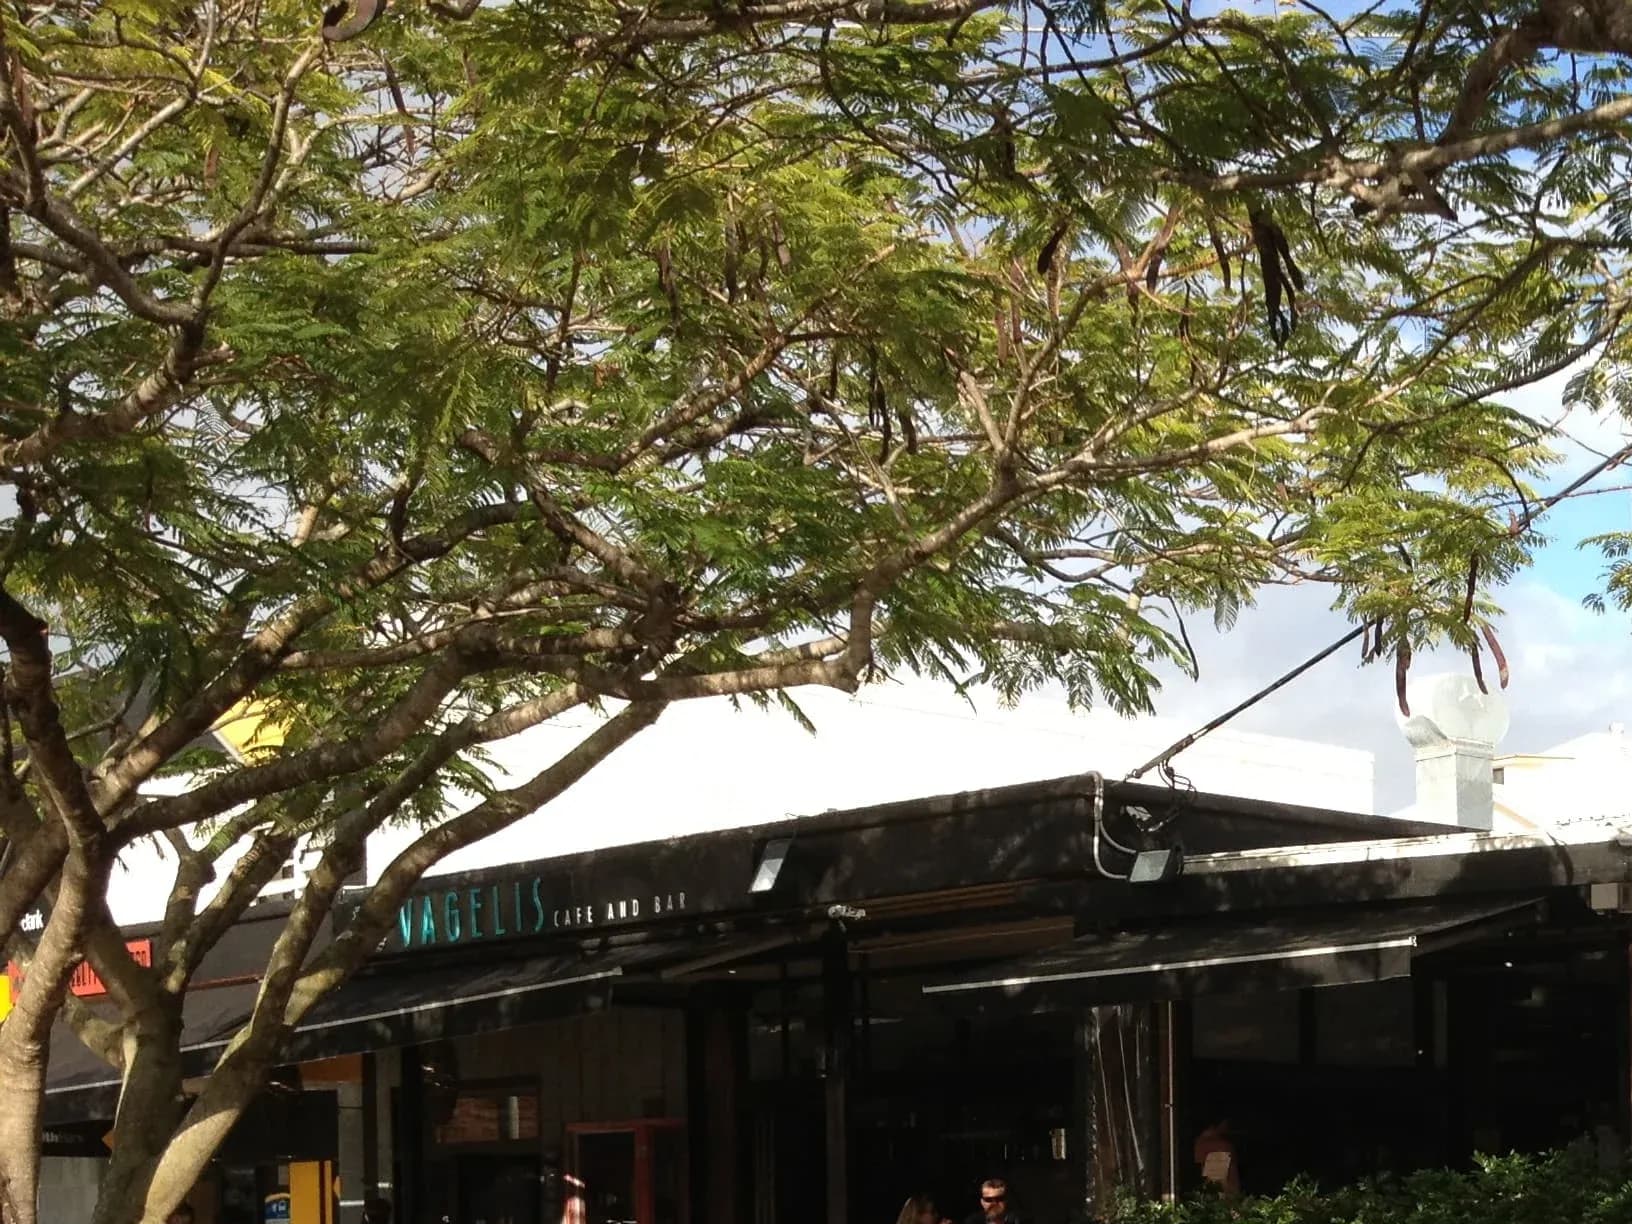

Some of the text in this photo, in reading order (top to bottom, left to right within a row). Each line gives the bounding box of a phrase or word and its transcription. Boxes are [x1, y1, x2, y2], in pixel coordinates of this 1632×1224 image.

[399, 877, 544, 948] VAGELIS
[554, 905, 594, 928] CAFE
[607, 898, 641, 921] AND
[654, 891, 687, 914] BAR
